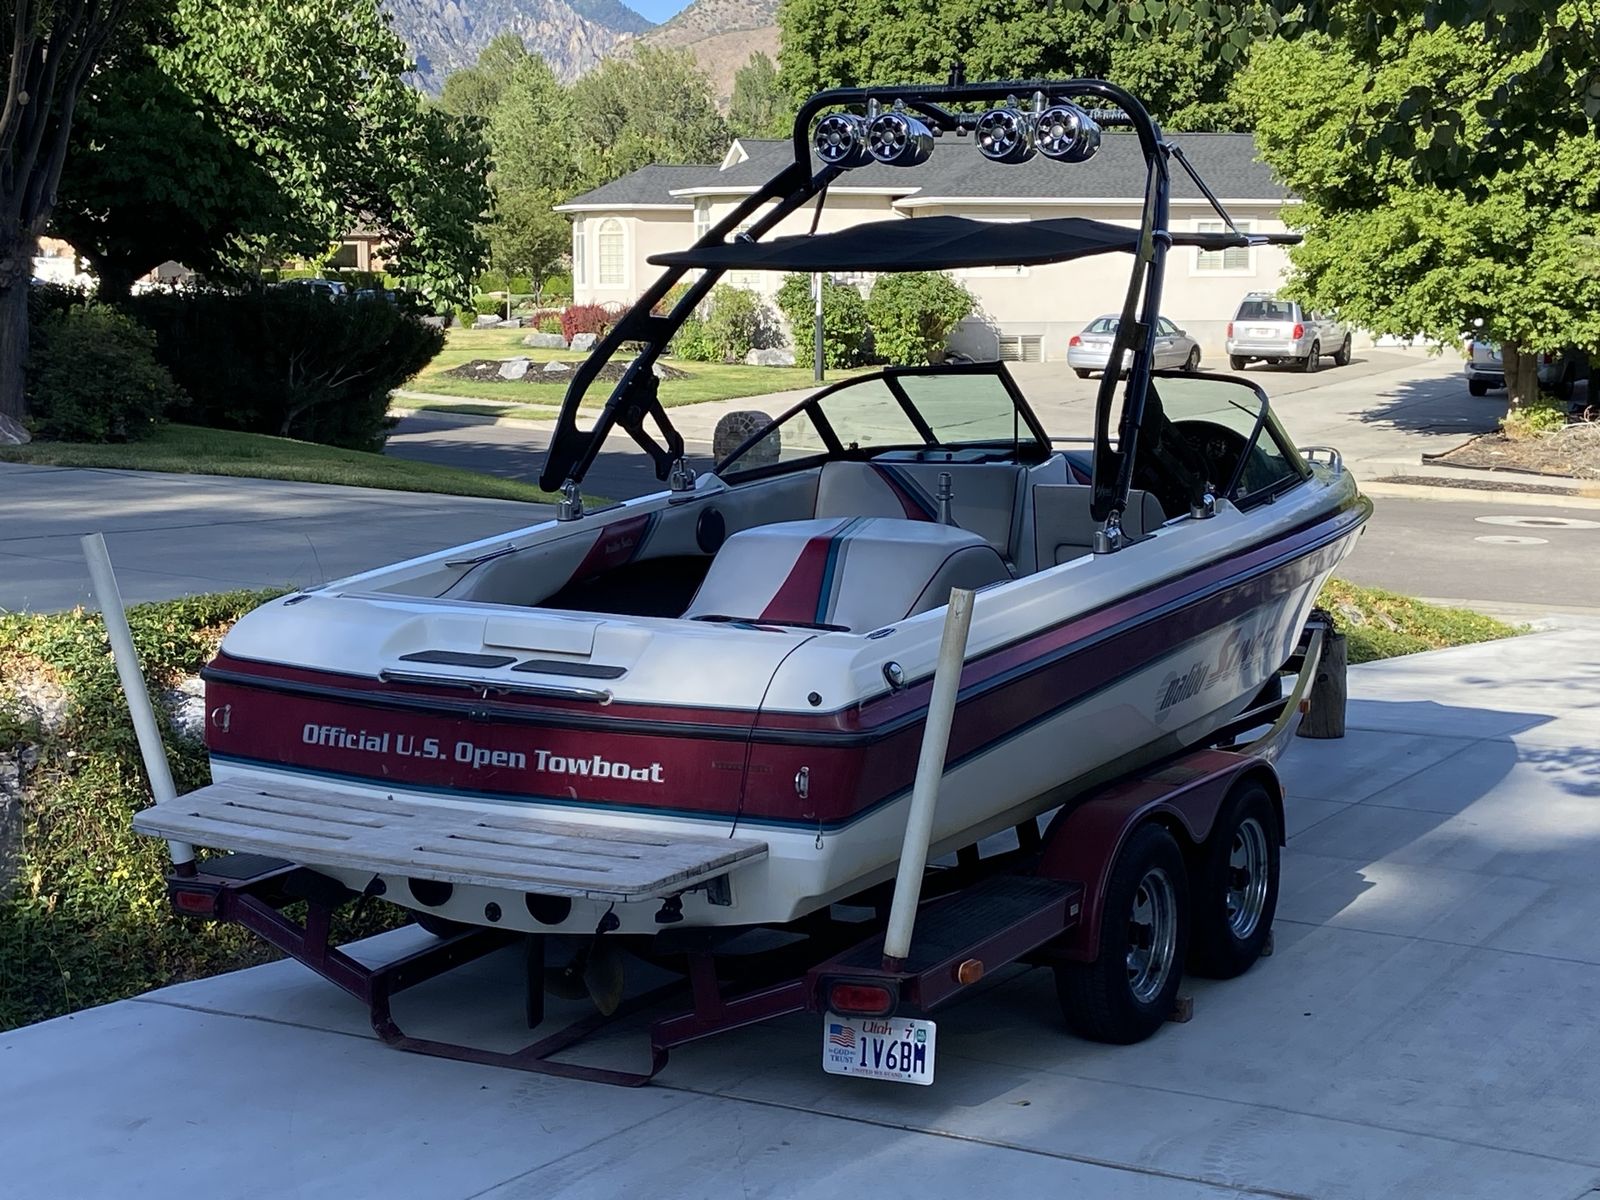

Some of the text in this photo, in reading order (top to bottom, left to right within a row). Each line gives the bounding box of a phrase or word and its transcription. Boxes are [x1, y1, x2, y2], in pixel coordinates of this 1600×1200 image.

[302, 723, 665, 783] Official U.S. Open Towboat
[862, 1021, 892, 1036] Utah
[905, 1028, 912, 1040] 7
[860, 1036, 926, 1075] 1V6BM
